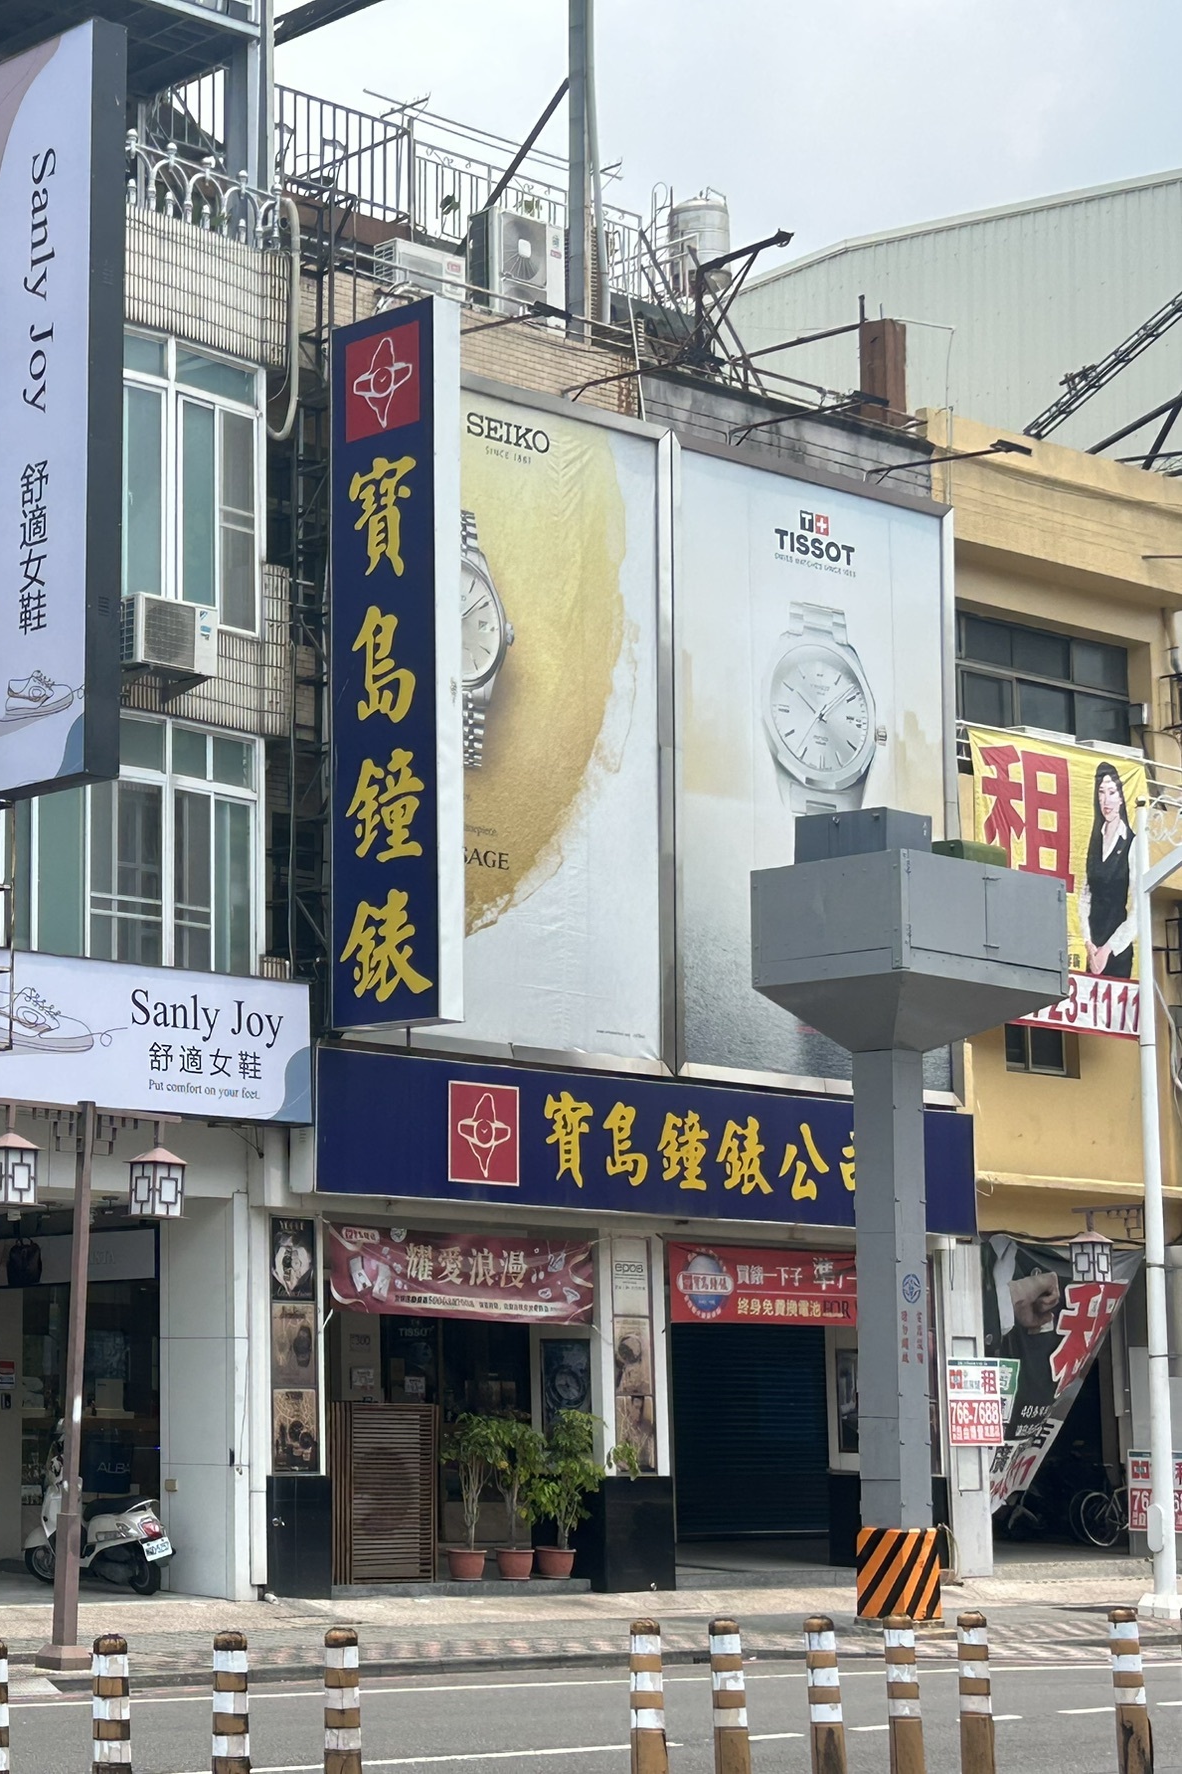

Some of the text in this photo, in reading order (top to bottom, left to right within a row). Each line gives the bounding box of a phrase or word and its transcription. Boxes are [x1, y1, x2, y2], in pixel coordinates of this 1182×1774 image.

[22, 148, 57, 413] Sanly Joy
[467, 412, 550, 454] SEIKO
[19, 460, 49, 636] 舒適女鞋
[774, 528, 855, 566] TISSOT
[340, 455, 433, 1003] 寶島鐘錶
[978, 745, 1075, 893] 租
[131, 989, 284, 1048] Sanly Joy
[149, 1042, 262, 1080] 舒適女鞋
[149, 1079, 164, 1091] Put
[167, 1082, 202, 1095] comfort
[204, 1086, 216, 1096] on
[218, 1089, 239, 1100] your
[405, 1242, 530, 1290] 耀愛浪漫
[615, 1263, 644, 1273] epos
[980, 1369, 998, 1395] 租
[950, 1401, 999, 1425] 766-7688
